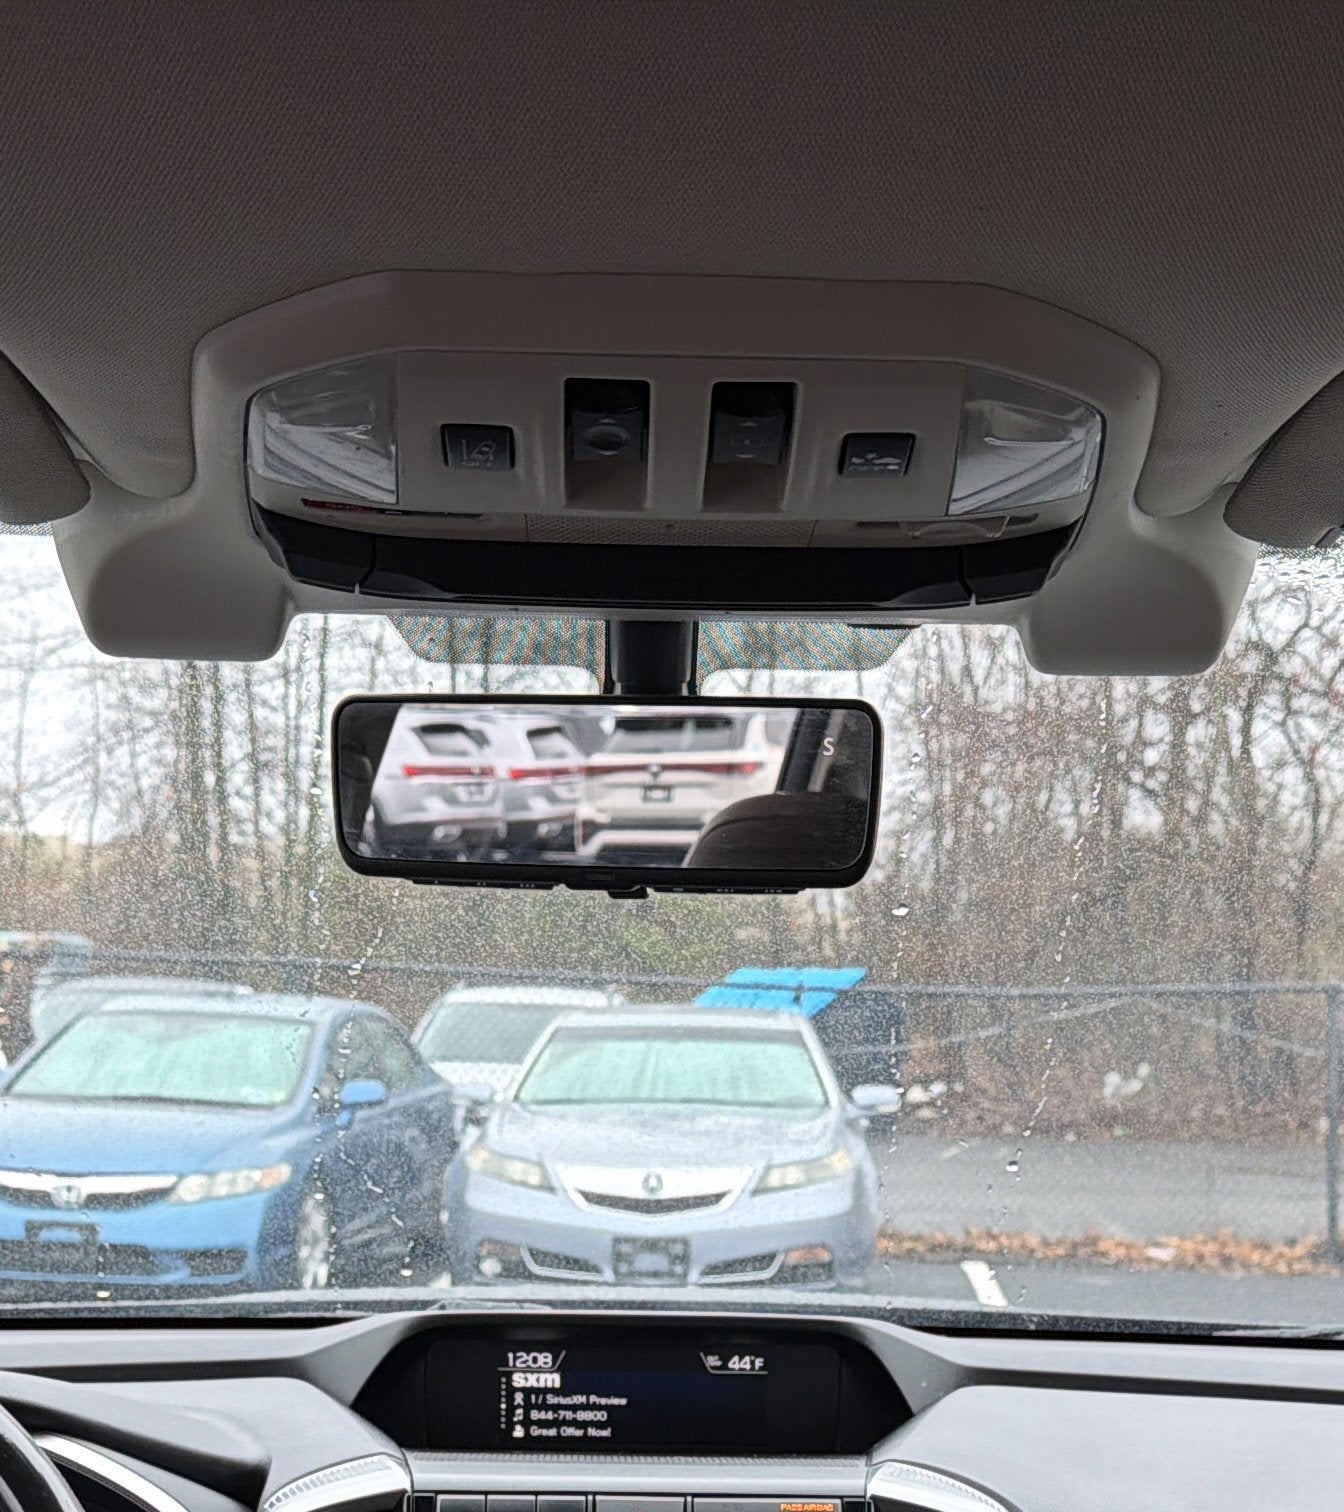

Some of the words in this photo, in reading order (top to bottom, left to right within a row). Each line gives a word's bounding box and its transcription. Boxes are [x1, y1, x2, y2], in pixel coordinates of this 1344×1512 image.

[512, 1372, 561, 1388] sxm
[589, 1394, 628, 1406] Preview
[530, 1410, 608, 1421] 844-711-8800
[530, 1426, 558, 1437] Great
[561, 1427, 585, 1437] Offer
